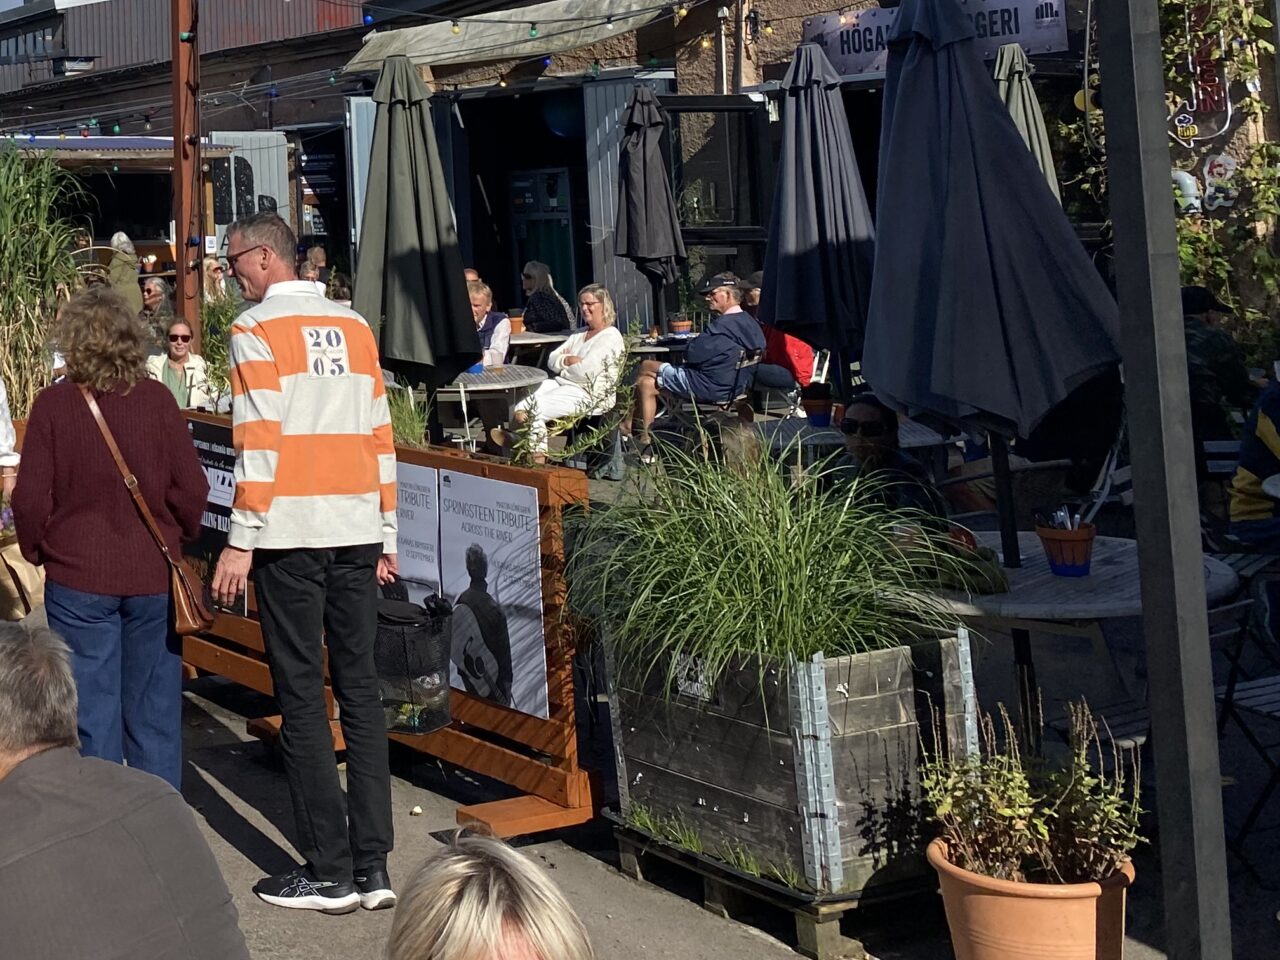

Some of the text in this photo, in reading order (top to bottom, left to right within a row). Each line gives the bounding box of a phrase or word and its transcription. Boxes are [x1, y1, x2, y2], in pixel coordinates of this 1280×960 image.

[840, 7, 1020, 56] HÖGA GERI
[308, 329, 342, 348] 20
[313, 356, 345, 377] 05
[400, 489, 431, 510] TRIBUTE
[400, 508, 415, 521] RIVER
[443, 497, 532, 531] SPRINGSTEEN TRIBUTE
[461, 521, 513, 543] ACROSS THE RIVER
